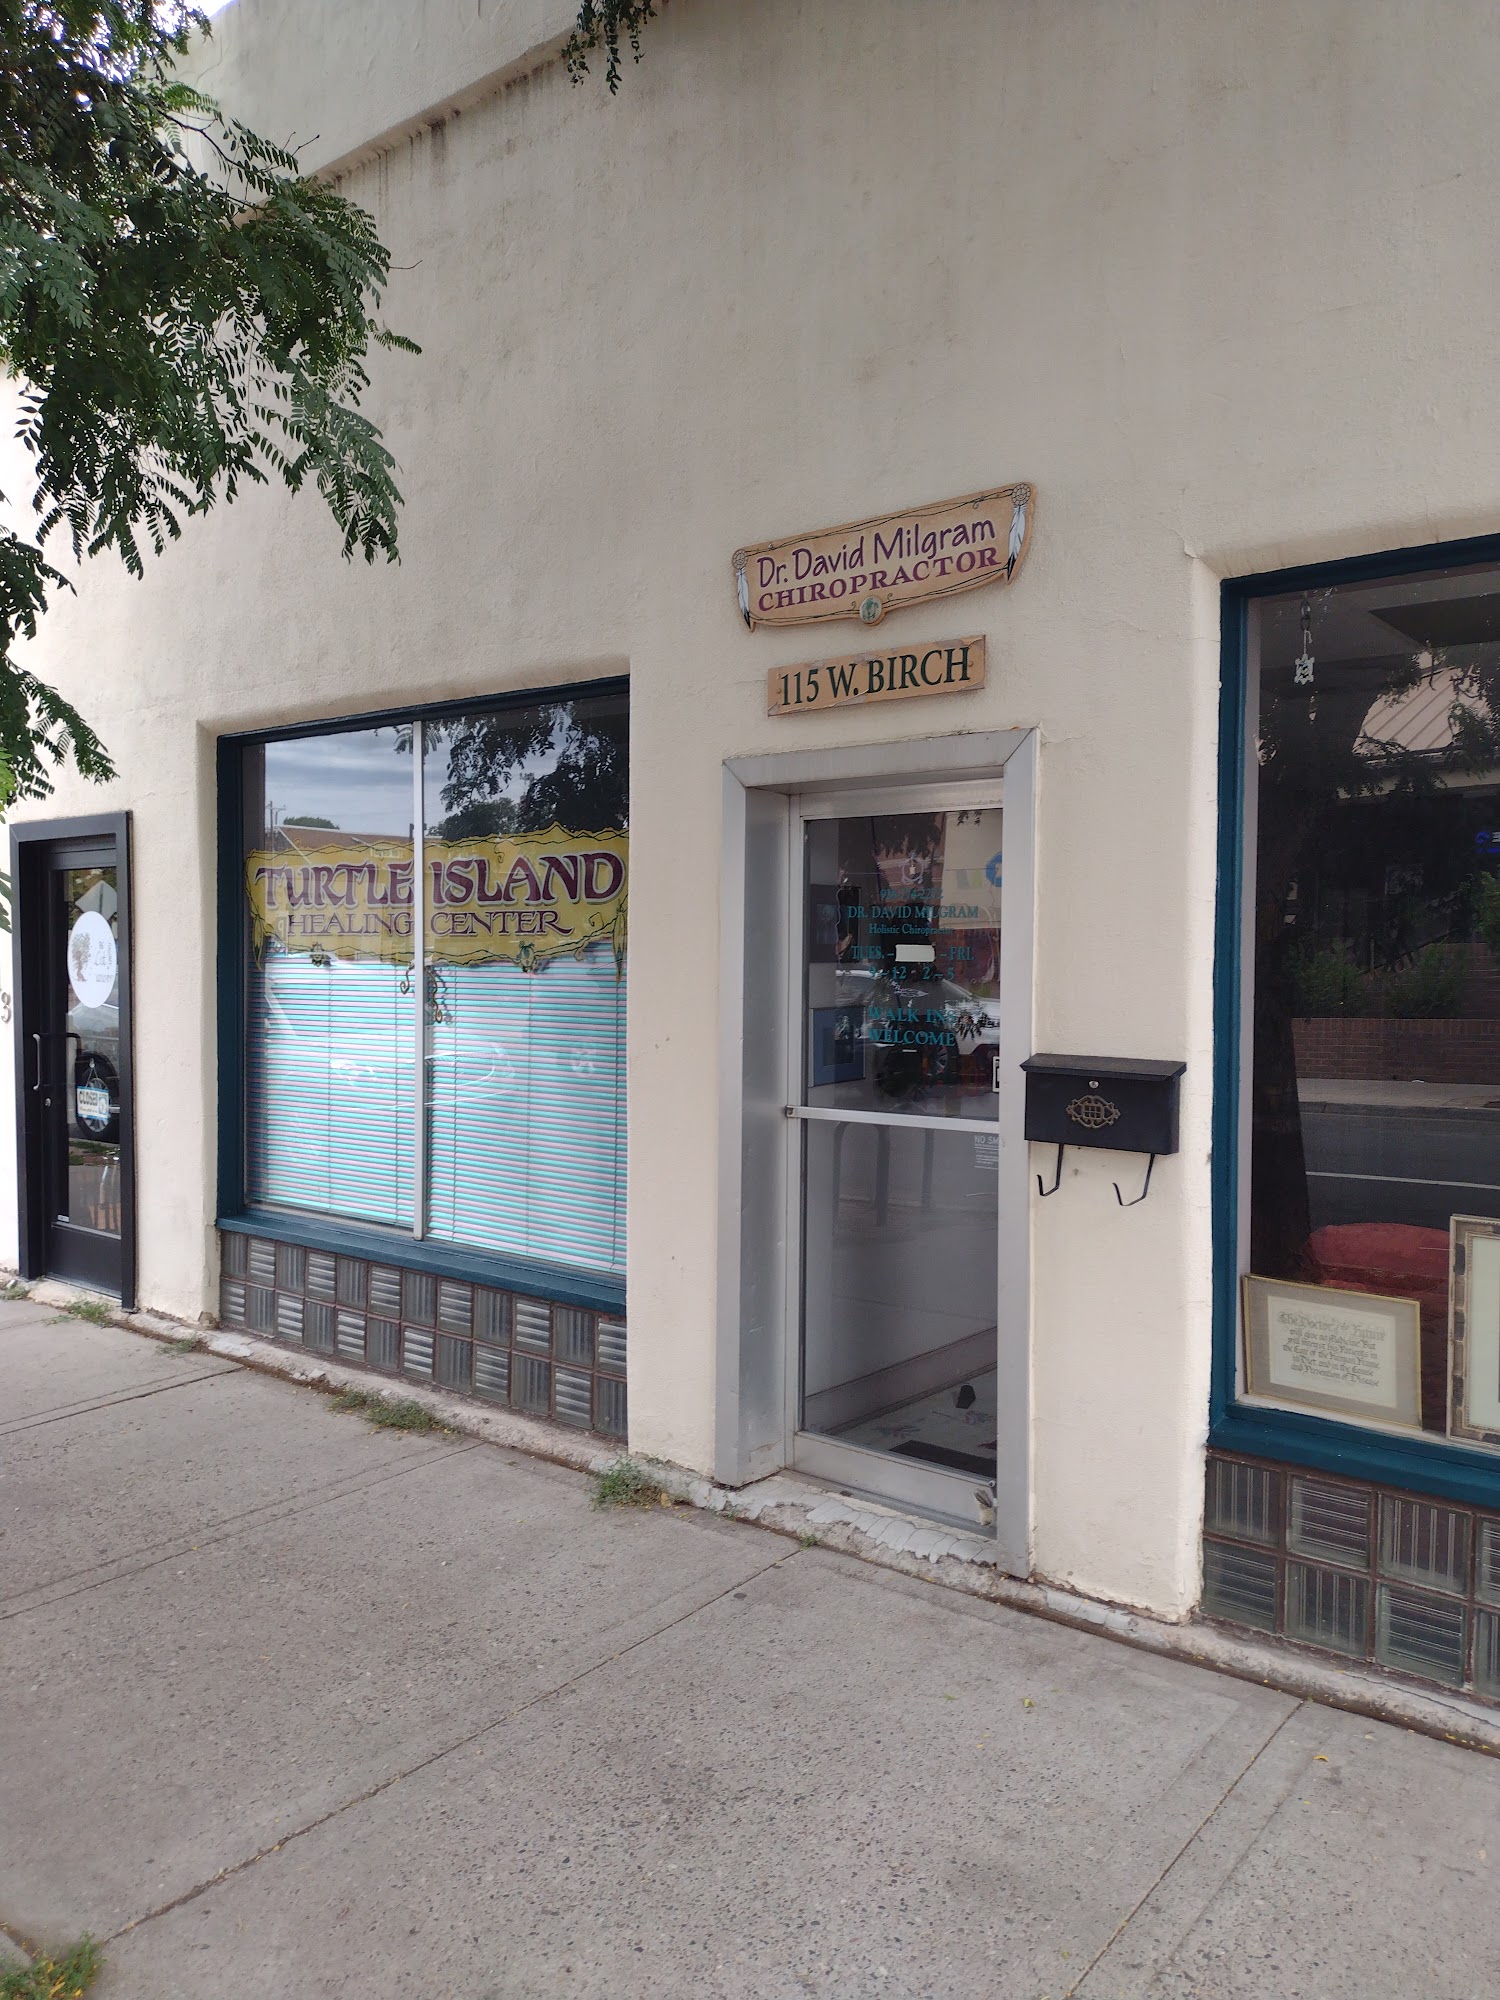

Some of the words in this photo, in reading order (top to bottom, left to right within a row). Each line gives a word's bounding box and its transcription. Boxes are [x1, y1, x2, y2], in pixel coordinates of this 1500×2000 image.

[757, 556, 788, 588] Dr.
[791, 535, 864, 581] David
[874, 518, 995, 564] Milgram
[758, 547, 1002, 612] CHIROPRACTOR
[781, 667, 819, 706] 115
[827, 663, 859, 698] W.
[868, 646, 971, 693] BIRCH
[254, 861, 415, 908] TURTLE
[428, 851, 627, 906] ISLAND
[847, 905, 868, 919] DR.
[871, 905, 912, 919] DAVID
[915, 904, 979, 919] MILGRAM
[287, 913, 415, 937] HEALING
[430, 909, 575, 937] CENTER
[869, 923, 900, 935] Holistic
[851, 946, 885, 961] TUES.
[948, 946, 976, 961] FRI.
[867, 1006, 920, 1023] WALK
[867, 1028, 957, 1047] WELCOME
[974, 1135, 986, 1144] NO
